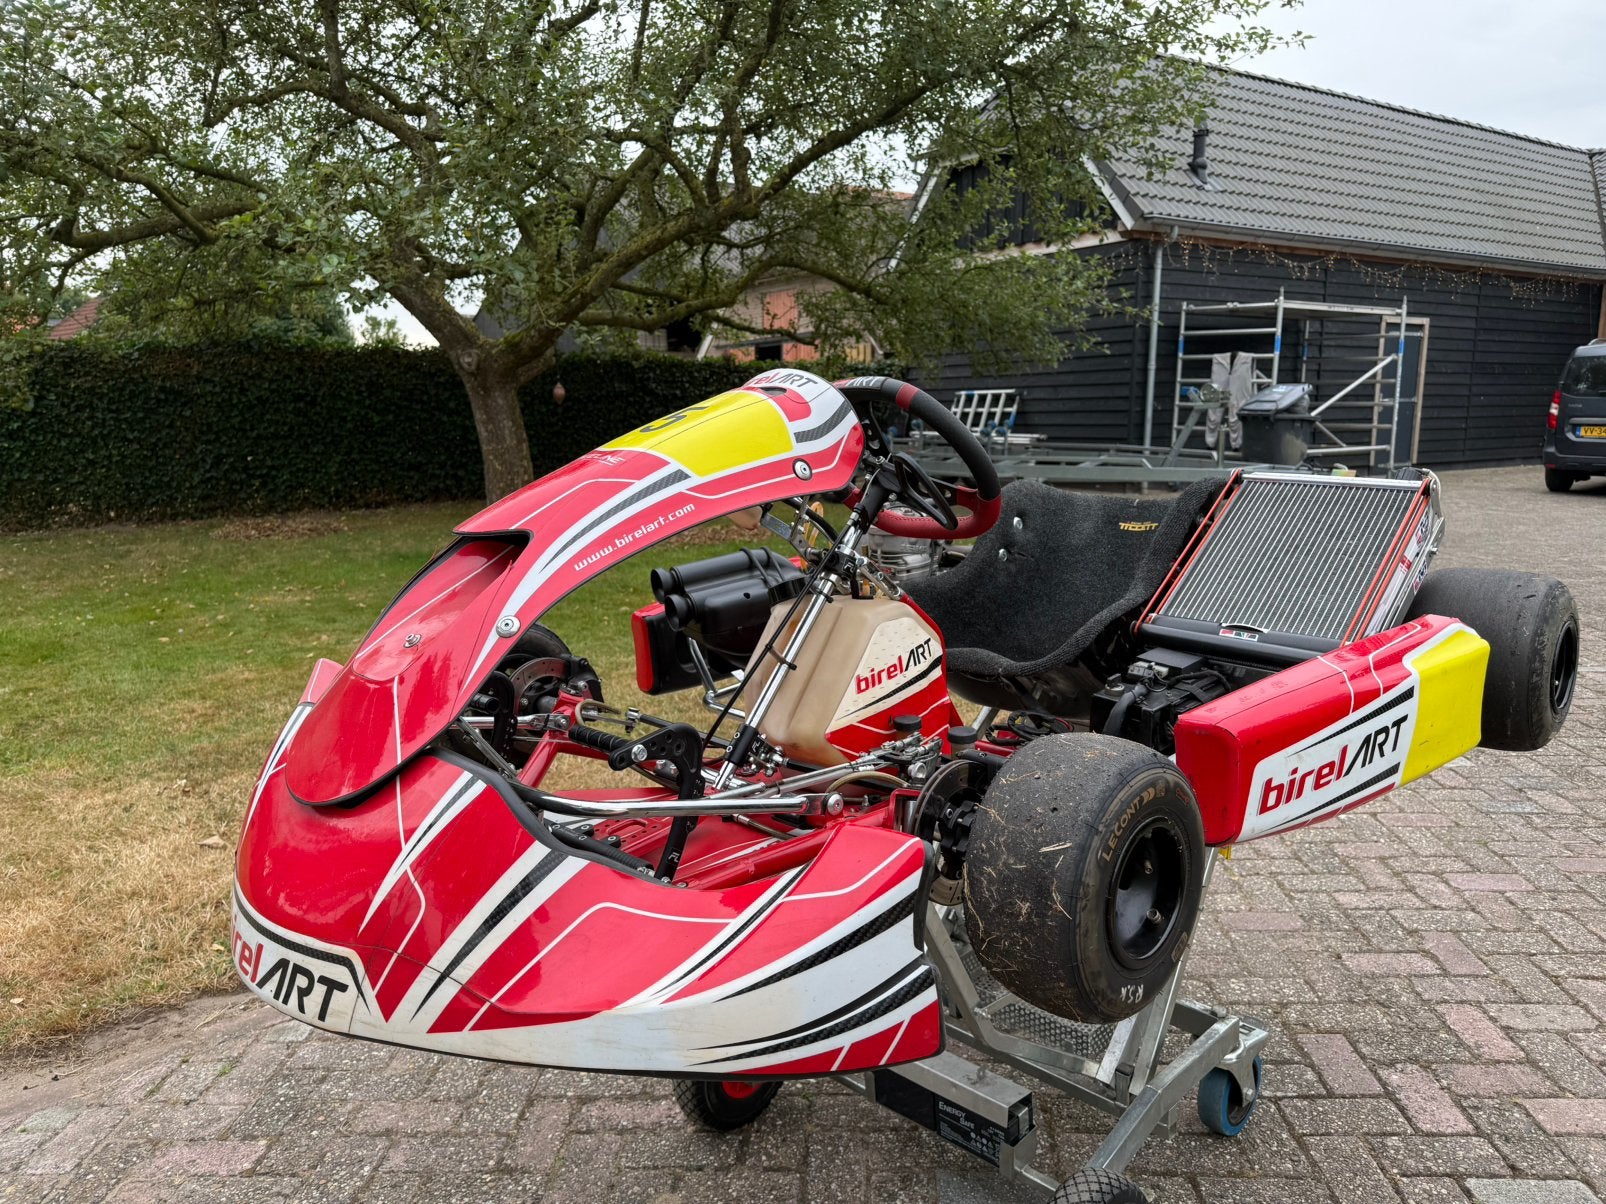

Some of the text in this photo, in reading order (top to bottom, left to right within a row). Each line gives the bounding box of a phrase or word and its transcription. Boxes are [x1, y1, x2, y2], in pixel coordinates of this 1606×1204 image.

[574, 503, 695, 571] www.birelart.com
[856, 638, 932, 694] birelART
[1257, 714, 1408, 816] birelART
